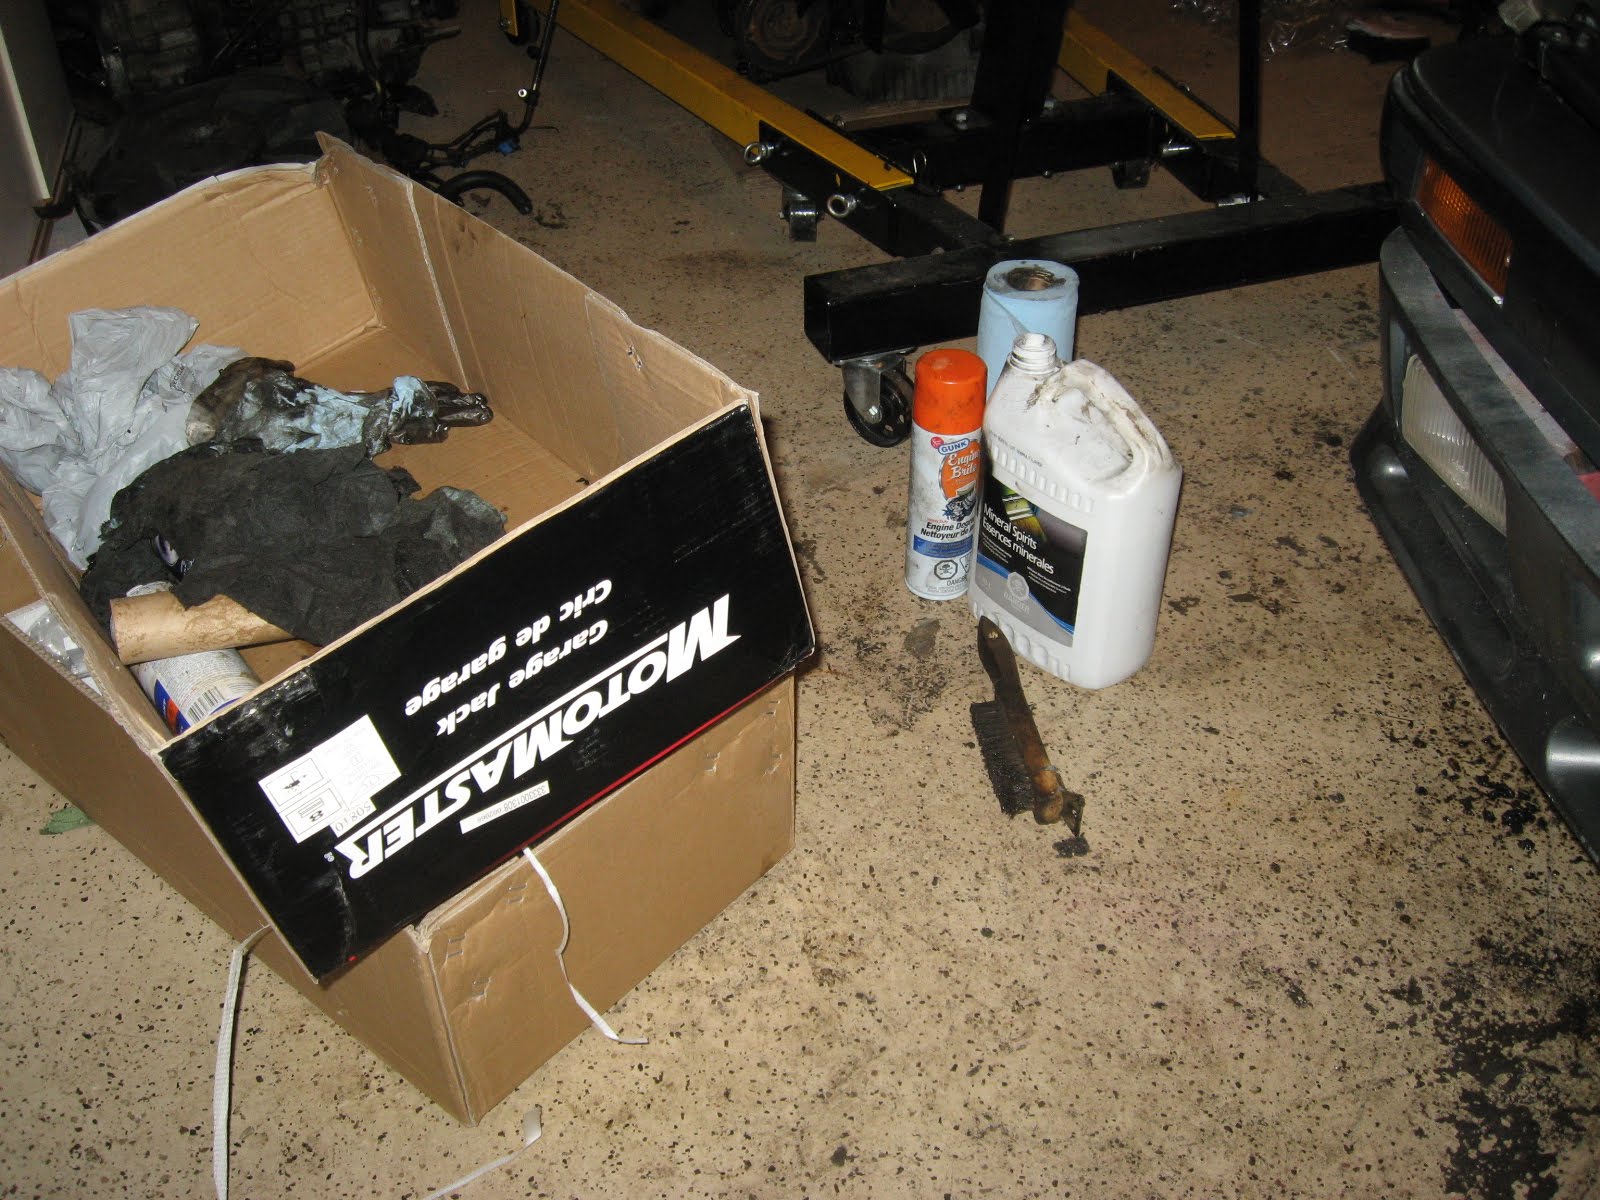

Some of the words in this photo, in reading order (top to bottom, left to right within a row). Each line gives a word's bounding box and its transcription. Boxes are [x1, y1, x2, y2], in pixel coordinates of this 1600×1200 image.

[941, 440, 968, 454] GUNK
[920, 527, 960, 541] Nettoyeur
[926, 521, 953, 533] Engine
[982, 517, 1013, 548] Essences
[1012, 542, 1055, 575] minerales
[983, 503, 1012, 532] Mineral
[1012, 527, 1037, 550] Spirits
[560, 578, 613, 619] Cric
[508, 619, 609, 690] Garage
[516, 619, 551, 652] de
[404, 634, 508, 717] garage
[436, 681, 501, 738] Jack
